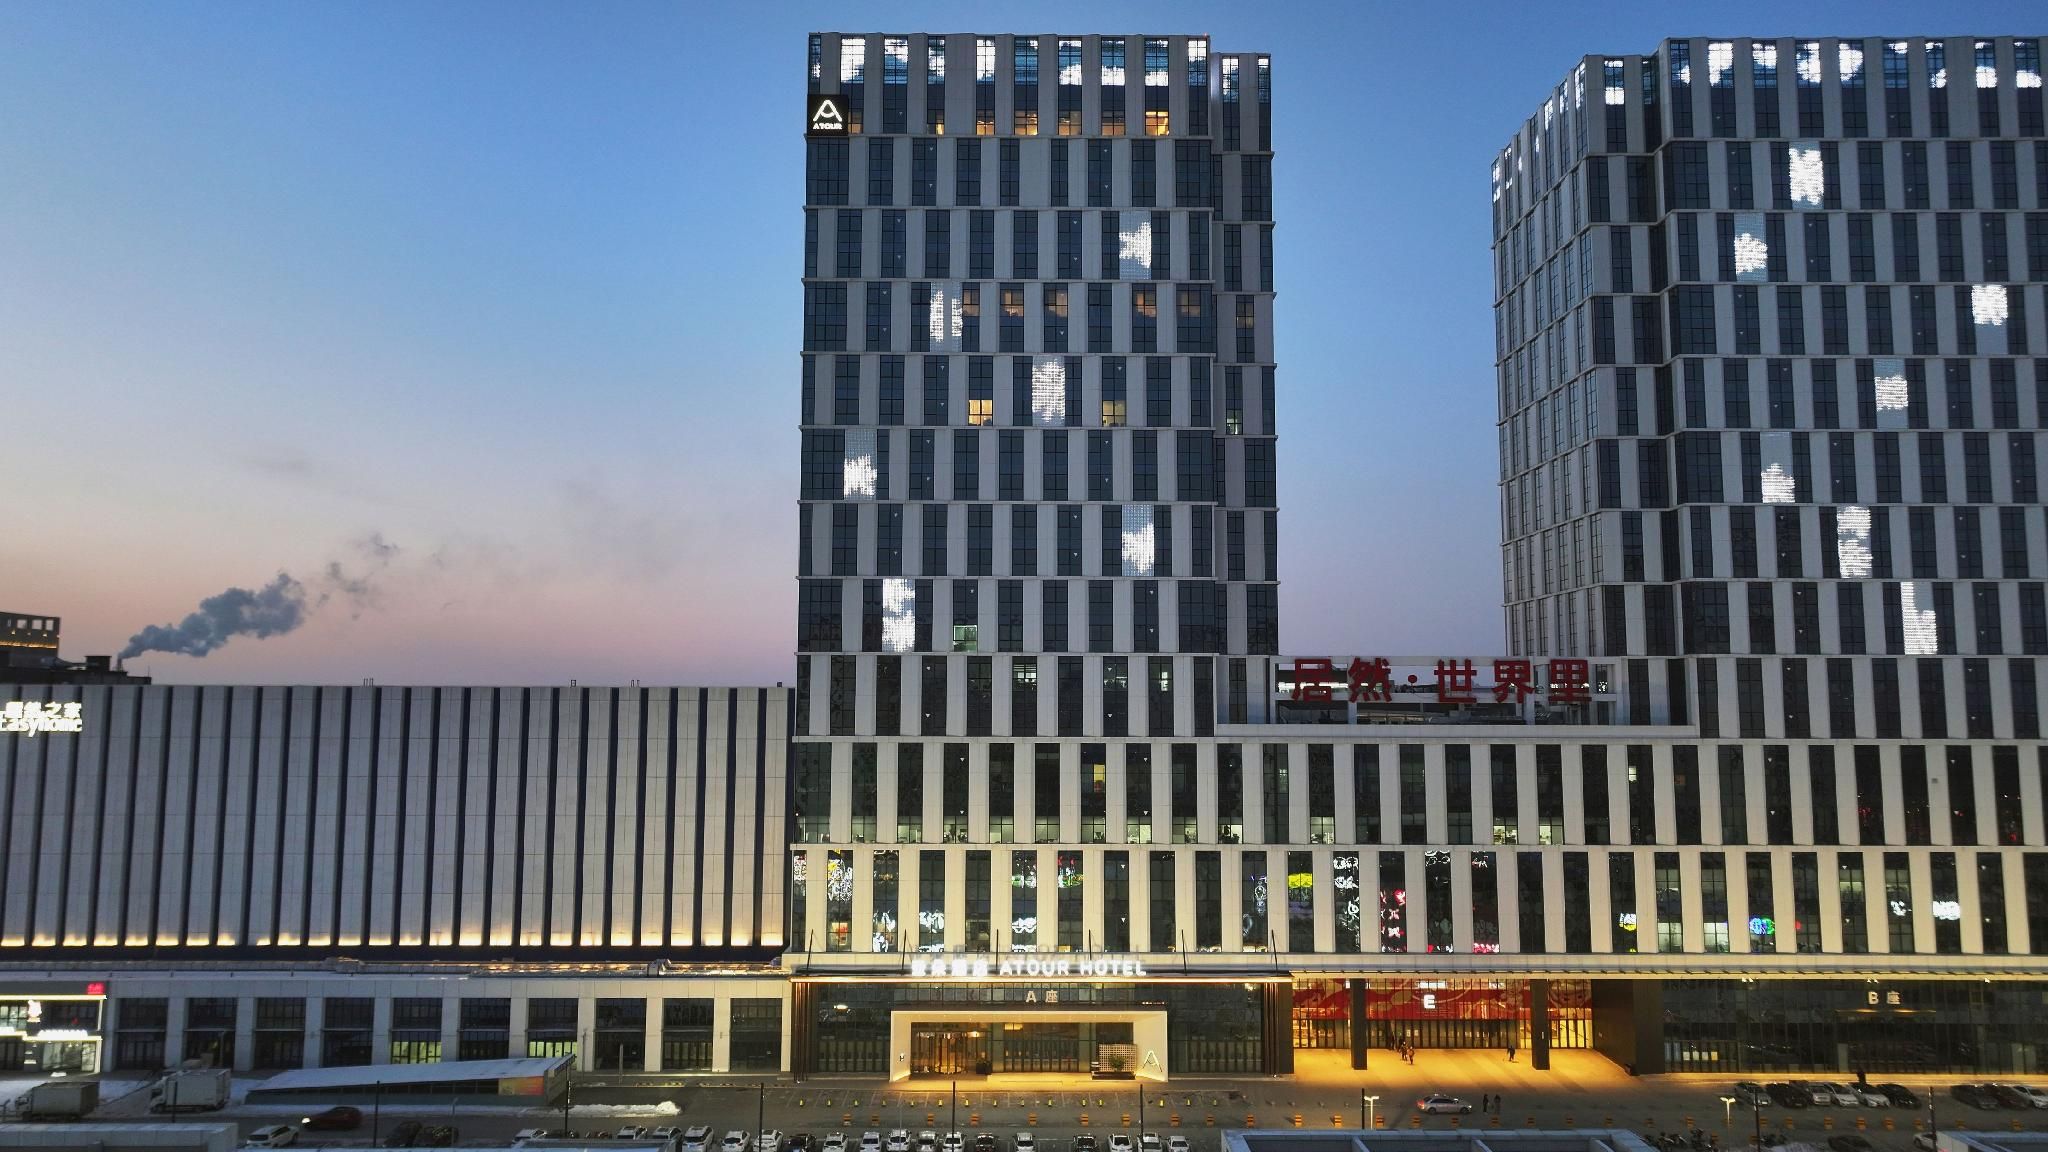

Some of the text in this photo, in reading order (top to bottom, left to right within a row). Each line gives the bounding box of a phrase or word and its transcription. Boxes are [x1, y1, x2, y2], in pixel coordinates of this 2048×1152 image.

[812, 122, 843, 130] ATOUR
[999, 959, 1070, 977] ATOUR
[1079, 959, 1147, 977] HOTEL
